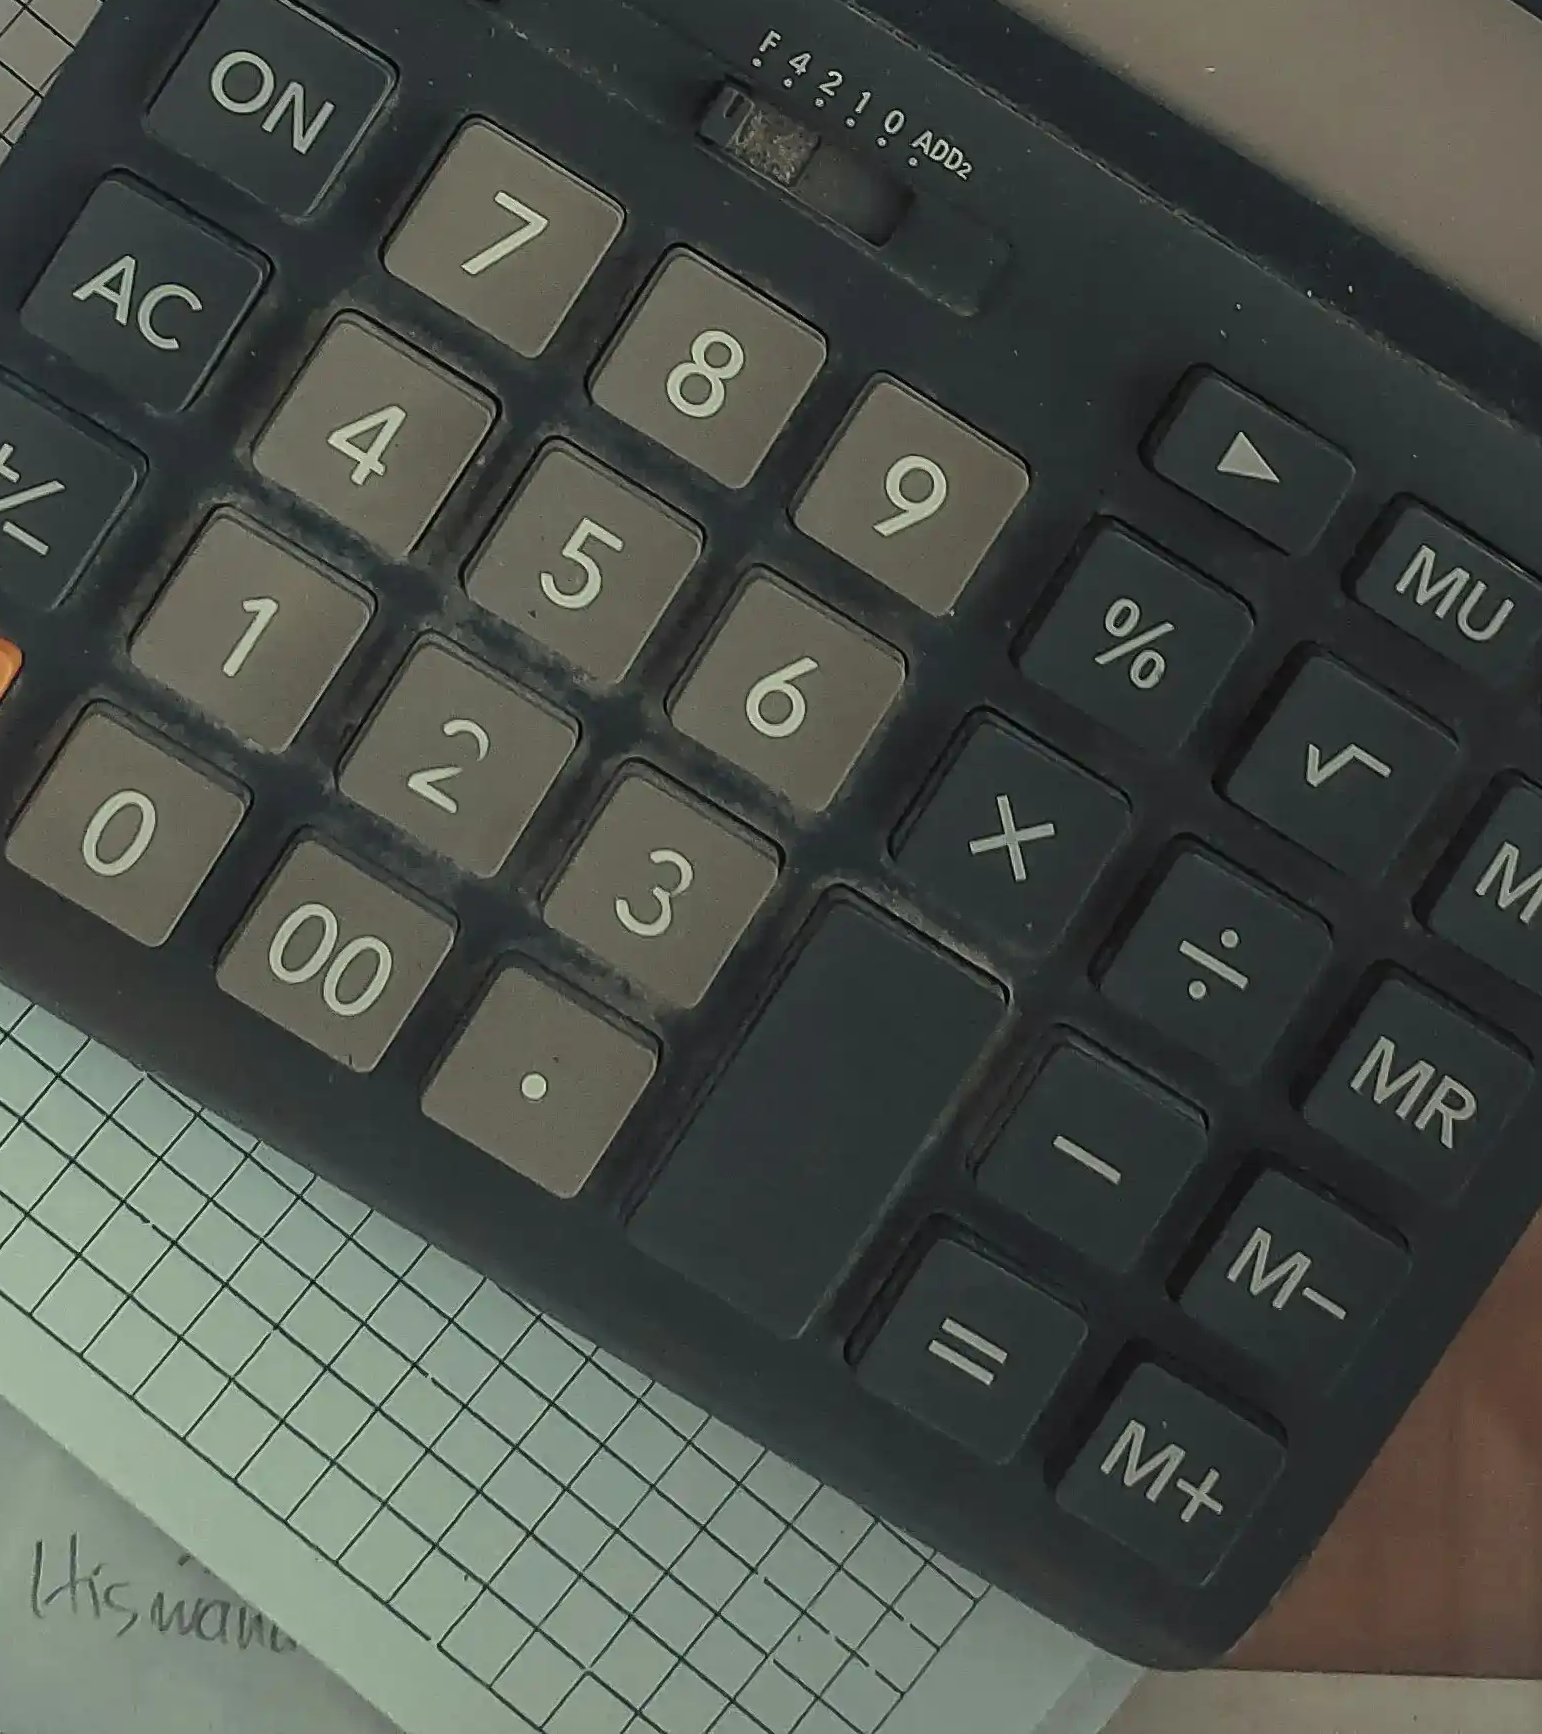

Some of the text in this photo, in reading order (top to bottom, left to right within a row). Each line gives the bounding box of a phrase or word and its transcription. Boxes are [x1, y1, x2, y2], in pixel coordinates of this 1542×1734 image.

[210, 51, 335, 155] ON
[758, 30, 782, 57] F
[787, 49, 814, 77] 4
[818, 69, 844, 96] 2
[852, 89, 873, 114] 1
[883, 108, 907, 136] 0
[461, 191, 548, 275] 7
[72, 255, 203, 350] AC
[666, 330, 744, 418] 8
[327, 405, 406, 486] 4
[873, 455, 947, 537] 9
[540, 517, 624, 609] 5
[1394, 543, 1516, 645] MU
[222, 598, 279, 677] 1
[1094, 598, 1175, 689] %
[745, 657, 818, 738] 6
[407, 719, 489, 814] 2
[82, 790, 156, 876] 0
[615, 850, 693, 936] 3
[269, 903, 392, 1016] 00
[1350, 1035, 1477, 1149] MR
[1100, 1419, 1224, 1523] M+
